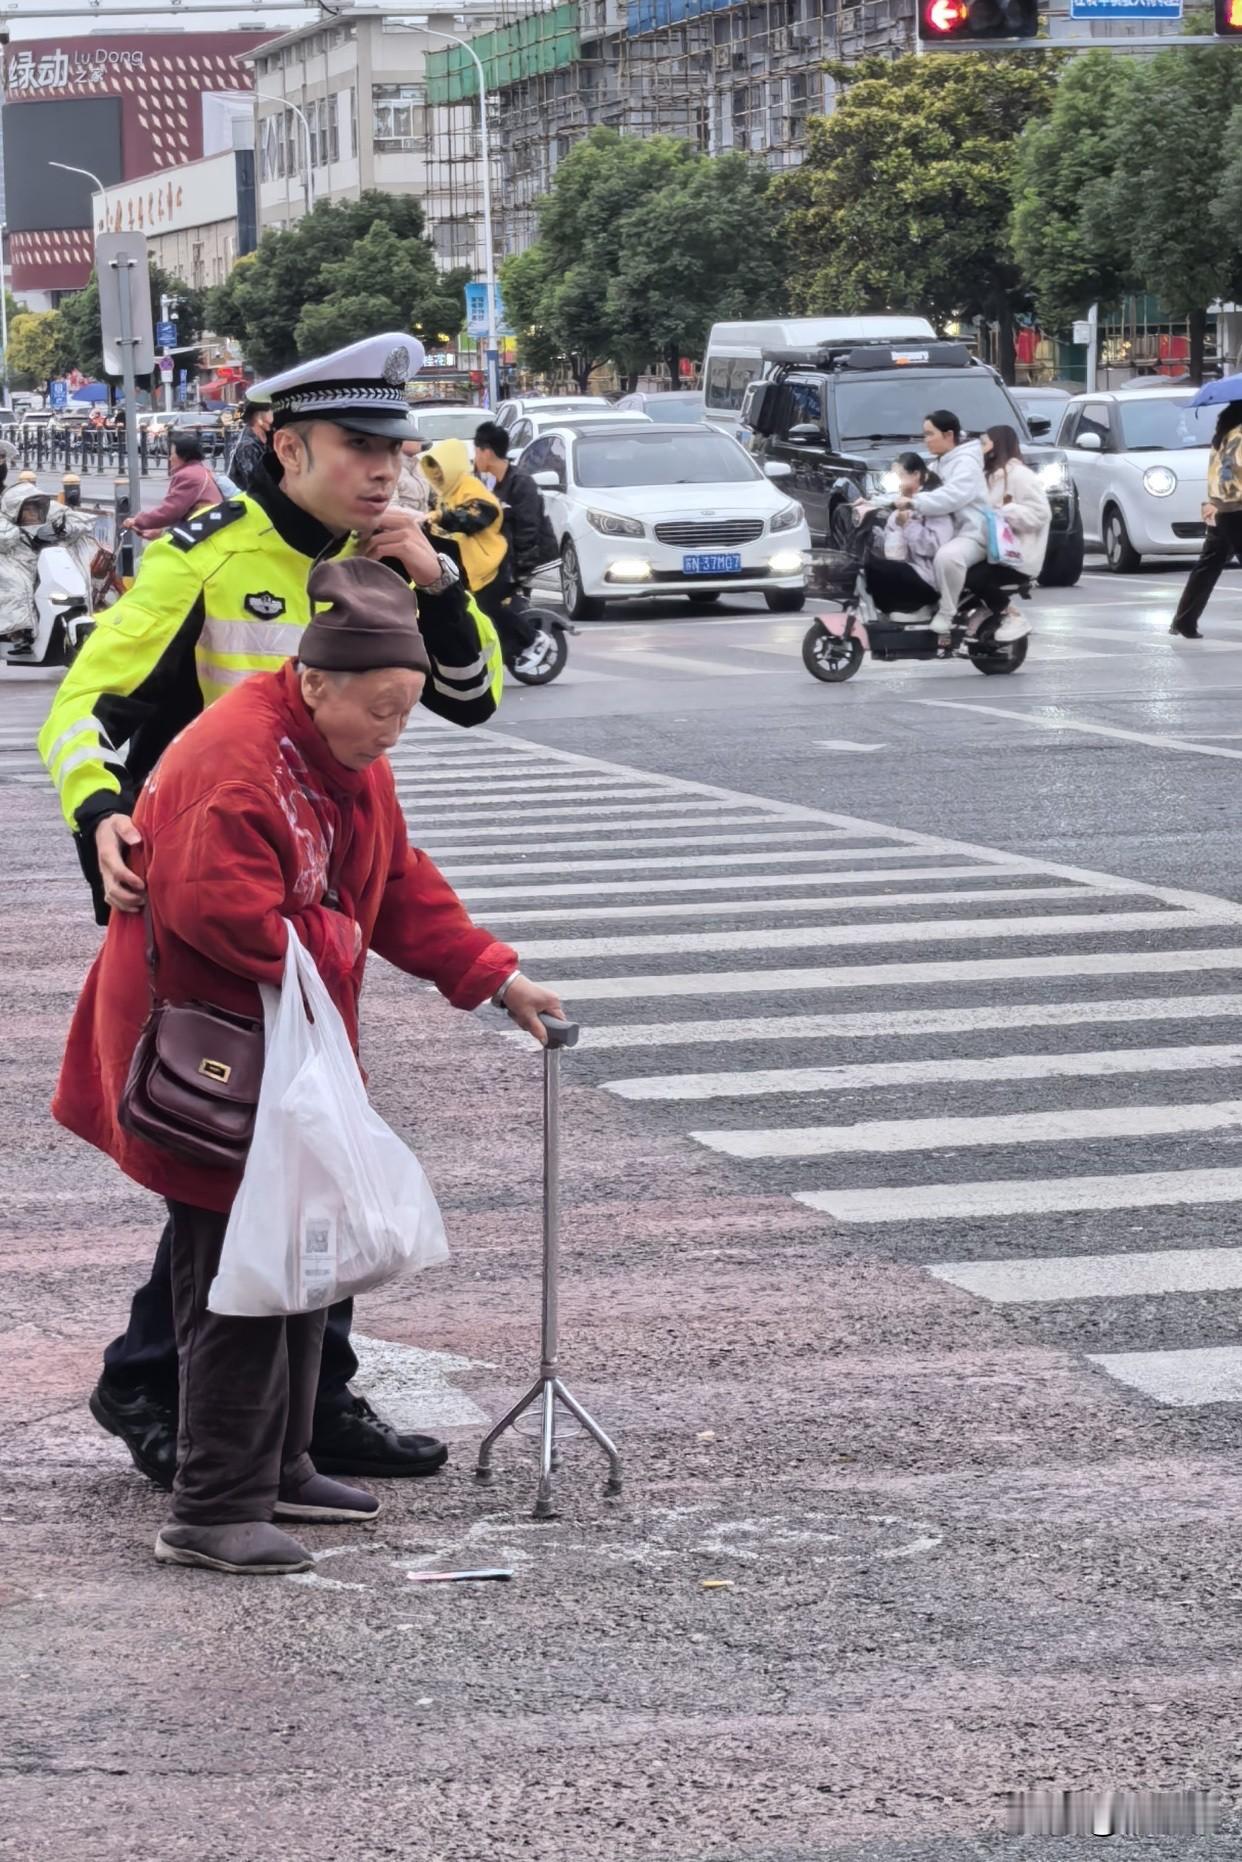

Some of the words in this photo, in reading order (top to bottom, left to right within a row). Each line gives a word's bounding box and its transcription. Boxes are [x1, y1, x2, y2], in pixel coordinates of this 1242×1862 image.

[95, 48, 143, 66] Dong
[8, 48, 69, 89] 绿动
[74, 68, 105, 84] 之家
